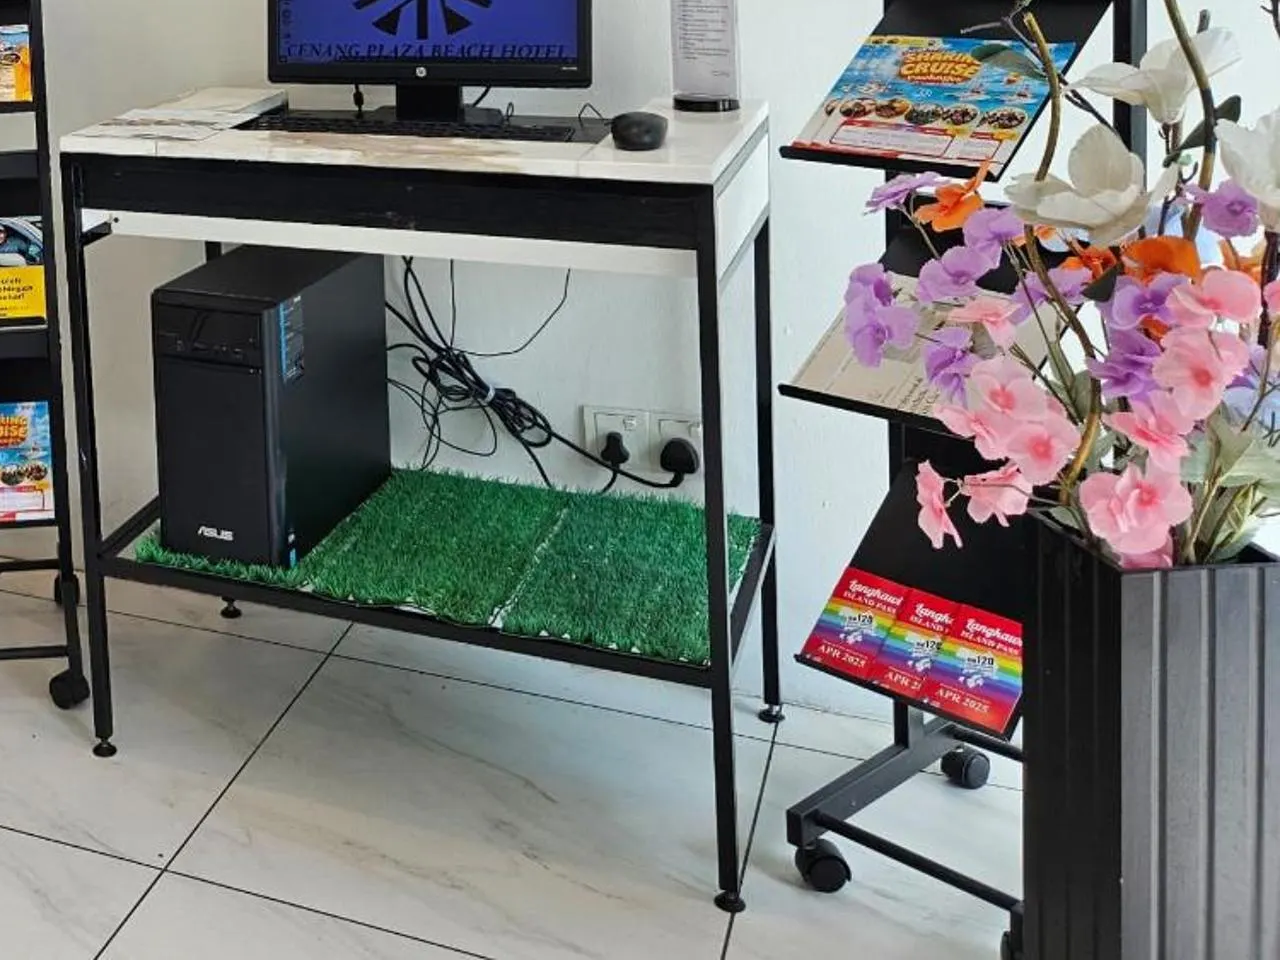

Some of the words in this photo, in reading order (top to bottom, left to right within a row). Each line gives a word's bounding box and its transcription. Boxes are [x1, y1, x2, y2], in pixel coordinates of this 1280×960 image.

[286, 42, 361, 59] CENANG
[366, 42, 426, 58] PLAZA
[431, 41, 494, 58] BEACH
[501, 41, 566, 58] HOTEL
[900, 60, 978, 78] CRUISE
[198, 525, 234, 541] ASUS
[842, 590, 875, 606] ISLAND
[959, 630, 995, 649] ISLAND
[819, 643, 841, 658] APR
[841, 653, 867, 669] 2025
[884, 670, 909, 687] APR
[935, 687, 961, 703] APR
[962, 696, 990, 713] 2025
